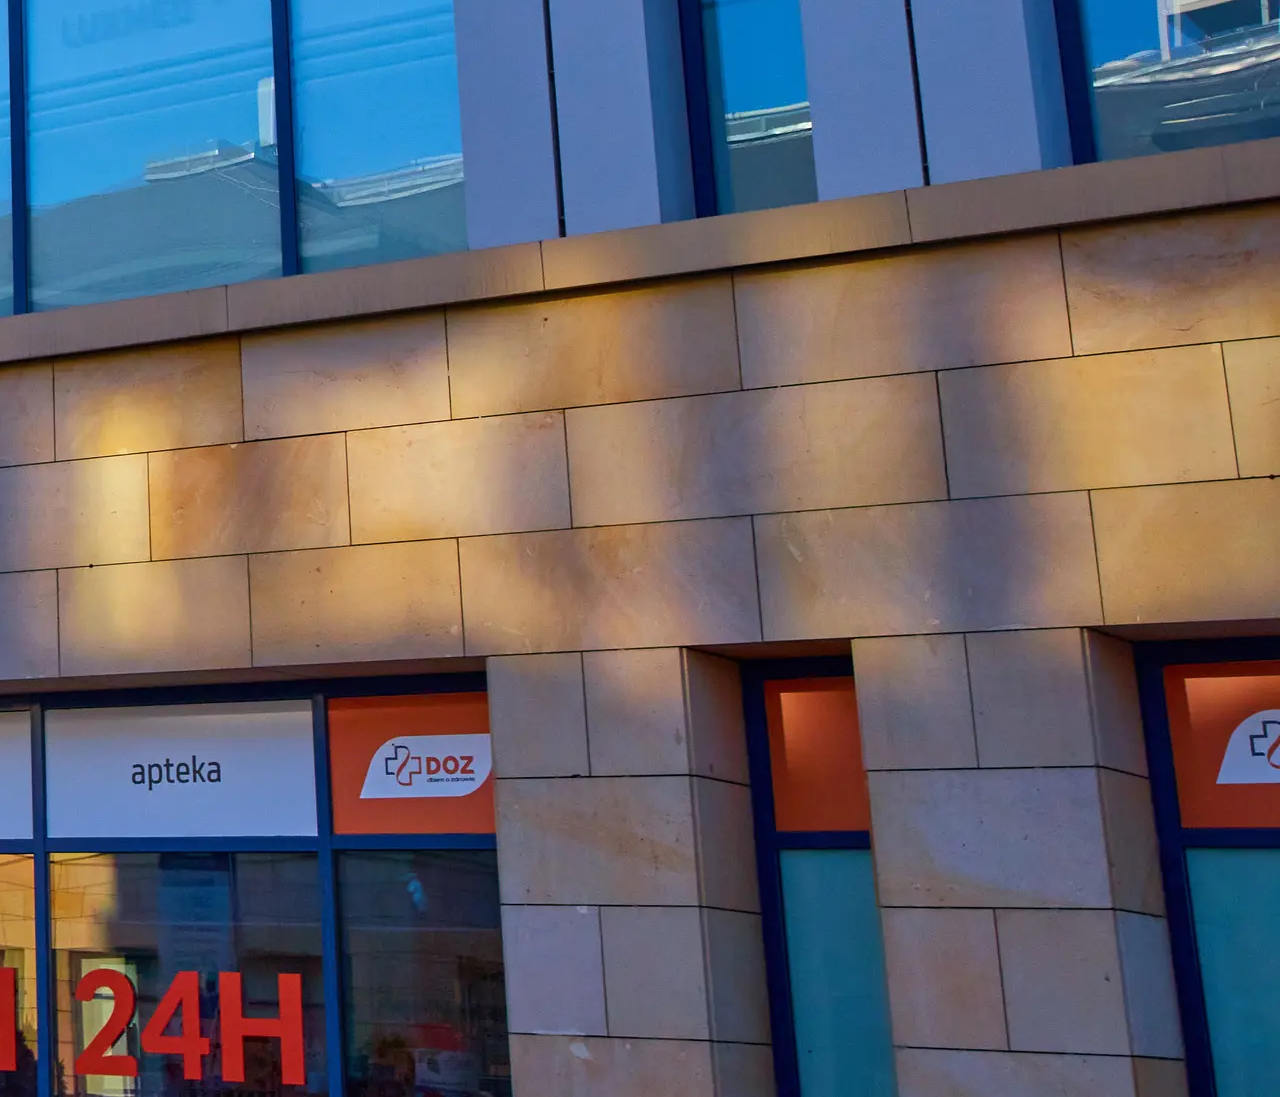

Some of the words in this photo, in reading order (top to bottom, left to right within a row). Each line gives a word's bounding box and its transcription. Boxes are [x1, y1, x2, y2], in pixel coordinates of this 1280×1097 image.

[131, 755, 222, 791] apteka
[426, 755, 475, 775] DOZ
[74, 968, 306, 1086] 24H
